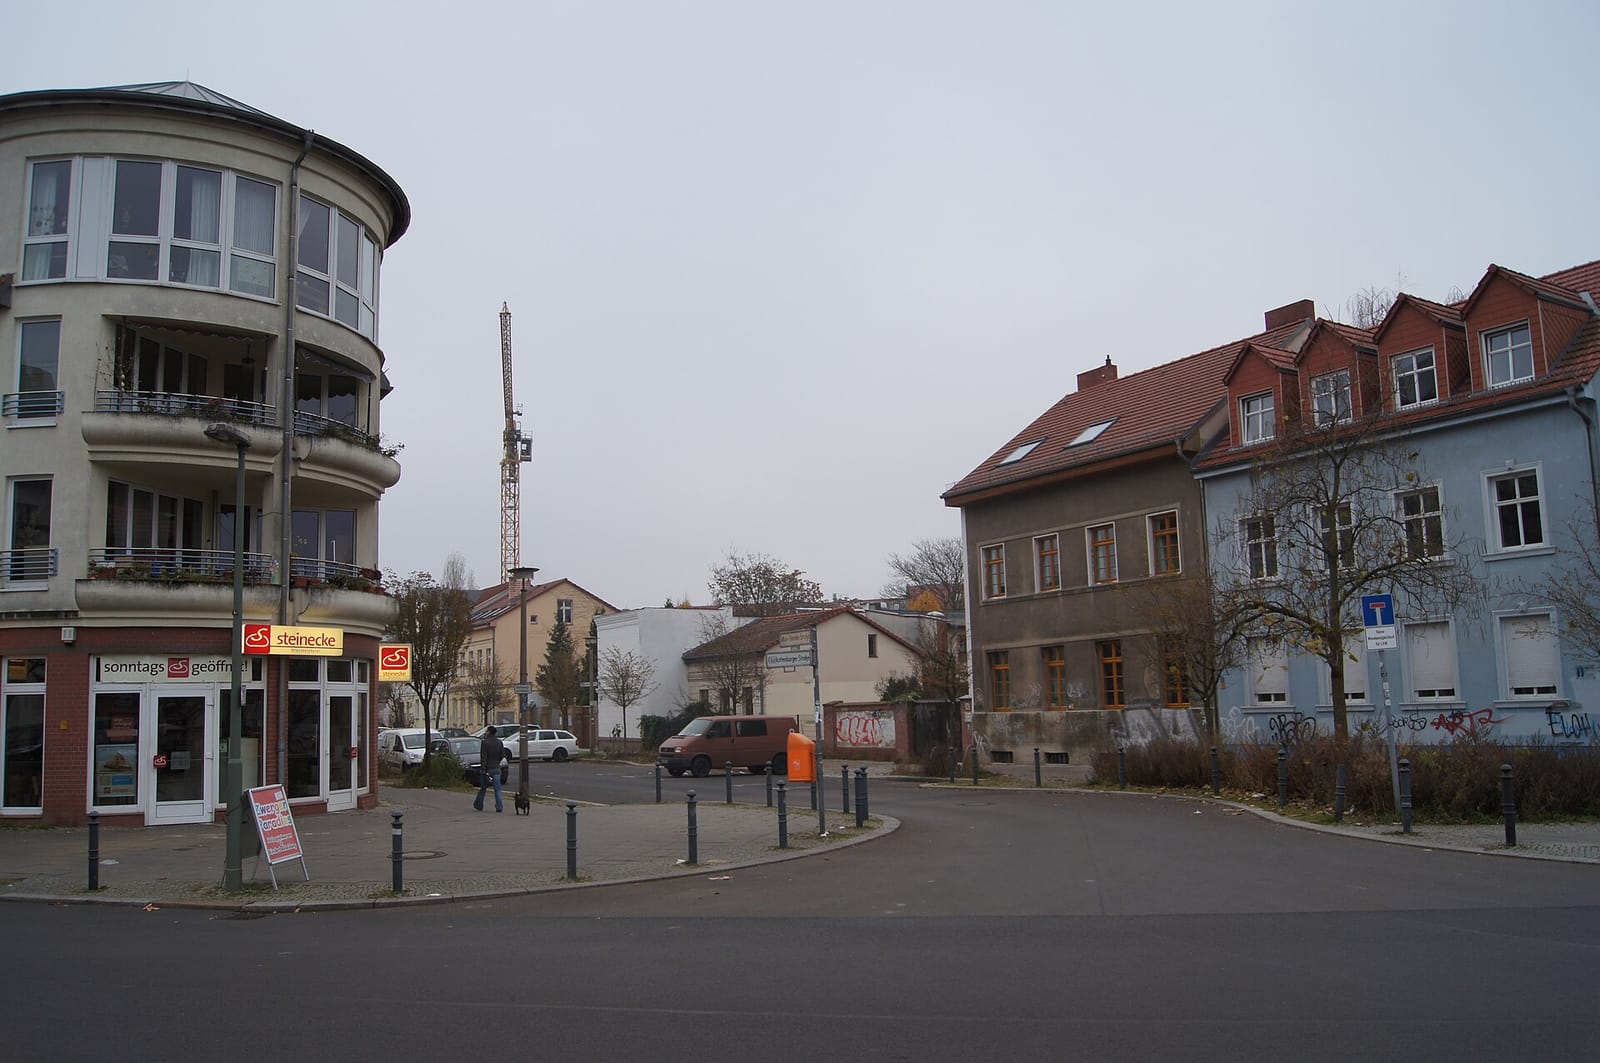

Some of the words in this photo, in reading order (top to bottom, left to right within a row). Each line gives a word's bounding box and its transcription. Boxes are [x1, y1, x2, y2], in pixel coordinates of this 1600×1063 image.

[276, 632, 336, 647] steinecke
[104, 660, 165, 676] sonntags
[192, 660, 248, 676] geöffn!
